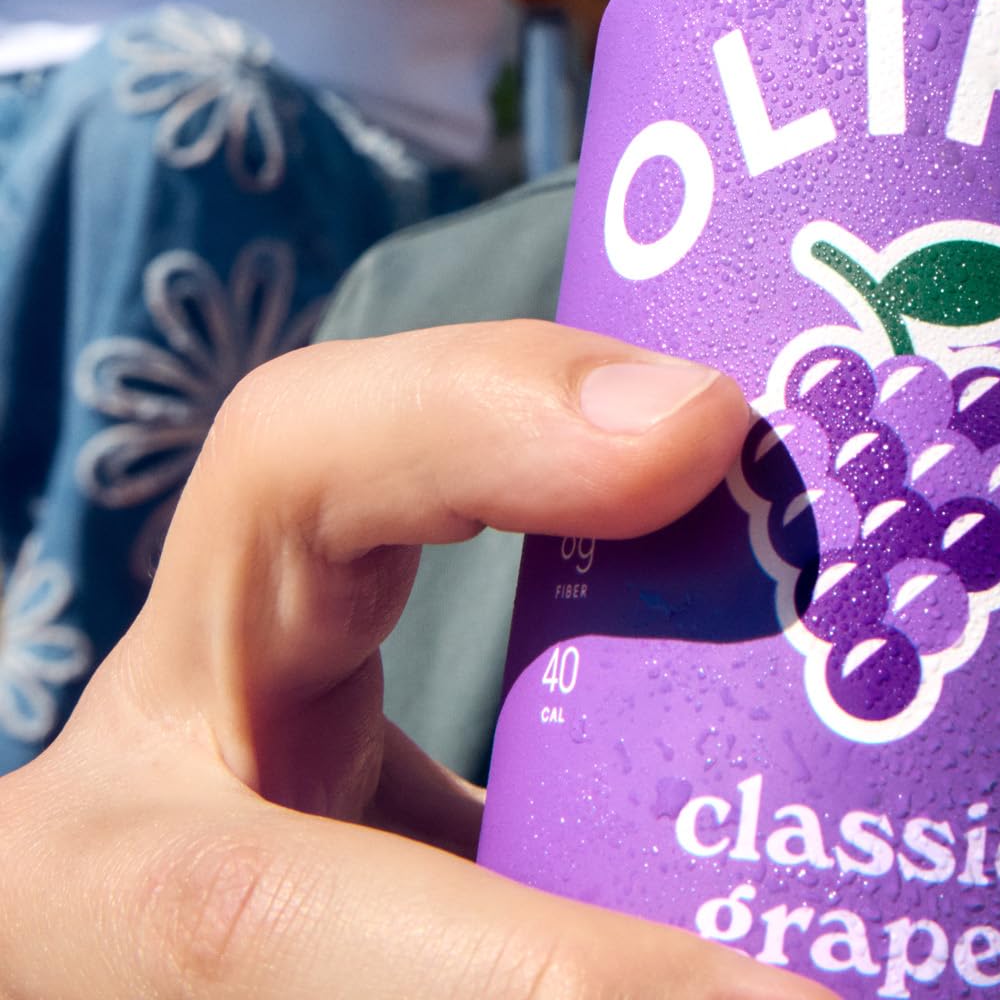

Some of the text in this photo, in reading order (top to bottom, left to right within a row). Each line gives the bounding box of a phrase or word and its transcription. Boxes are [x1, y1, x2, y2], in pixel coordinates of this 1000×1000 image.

[555, 584, 588, 599] FIBER
[542, 646, 579, 693] 40
[541, 706, 565, 723] CAL
